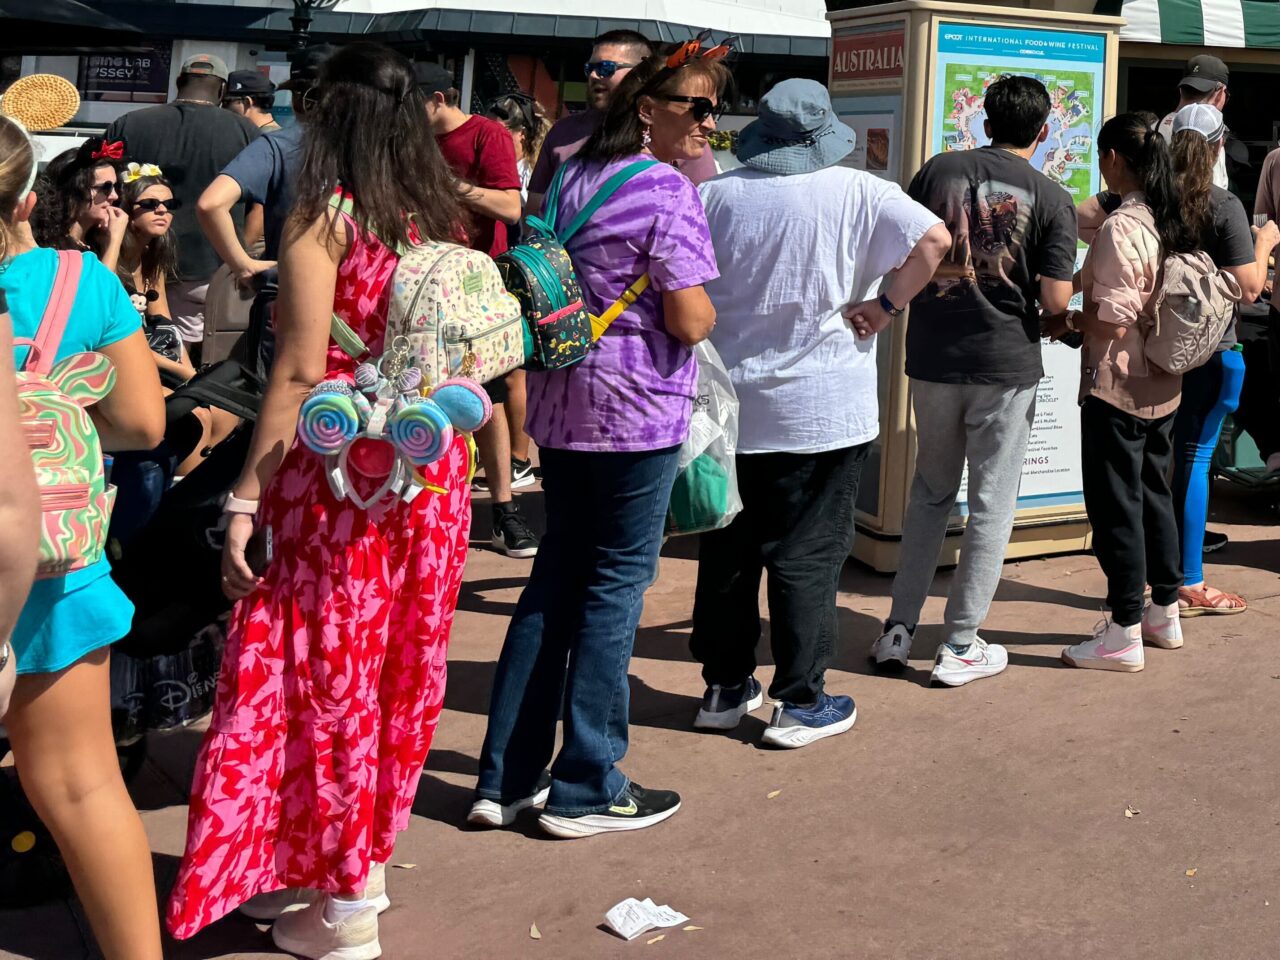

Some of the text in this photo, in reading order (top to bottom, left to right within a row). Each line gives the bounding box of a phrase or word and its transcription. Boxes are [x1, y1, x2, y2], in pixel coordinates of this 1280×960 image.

[944, 33, 963, 41] EPCOT
[965, 35, 1023, 46] INTERNATIONAL
[1067, 42, 1099, 51] FESTIVAL
[834, 46, 904, 73] AUSTRALIA
[1022, 456, 1049, 465] RINGS
